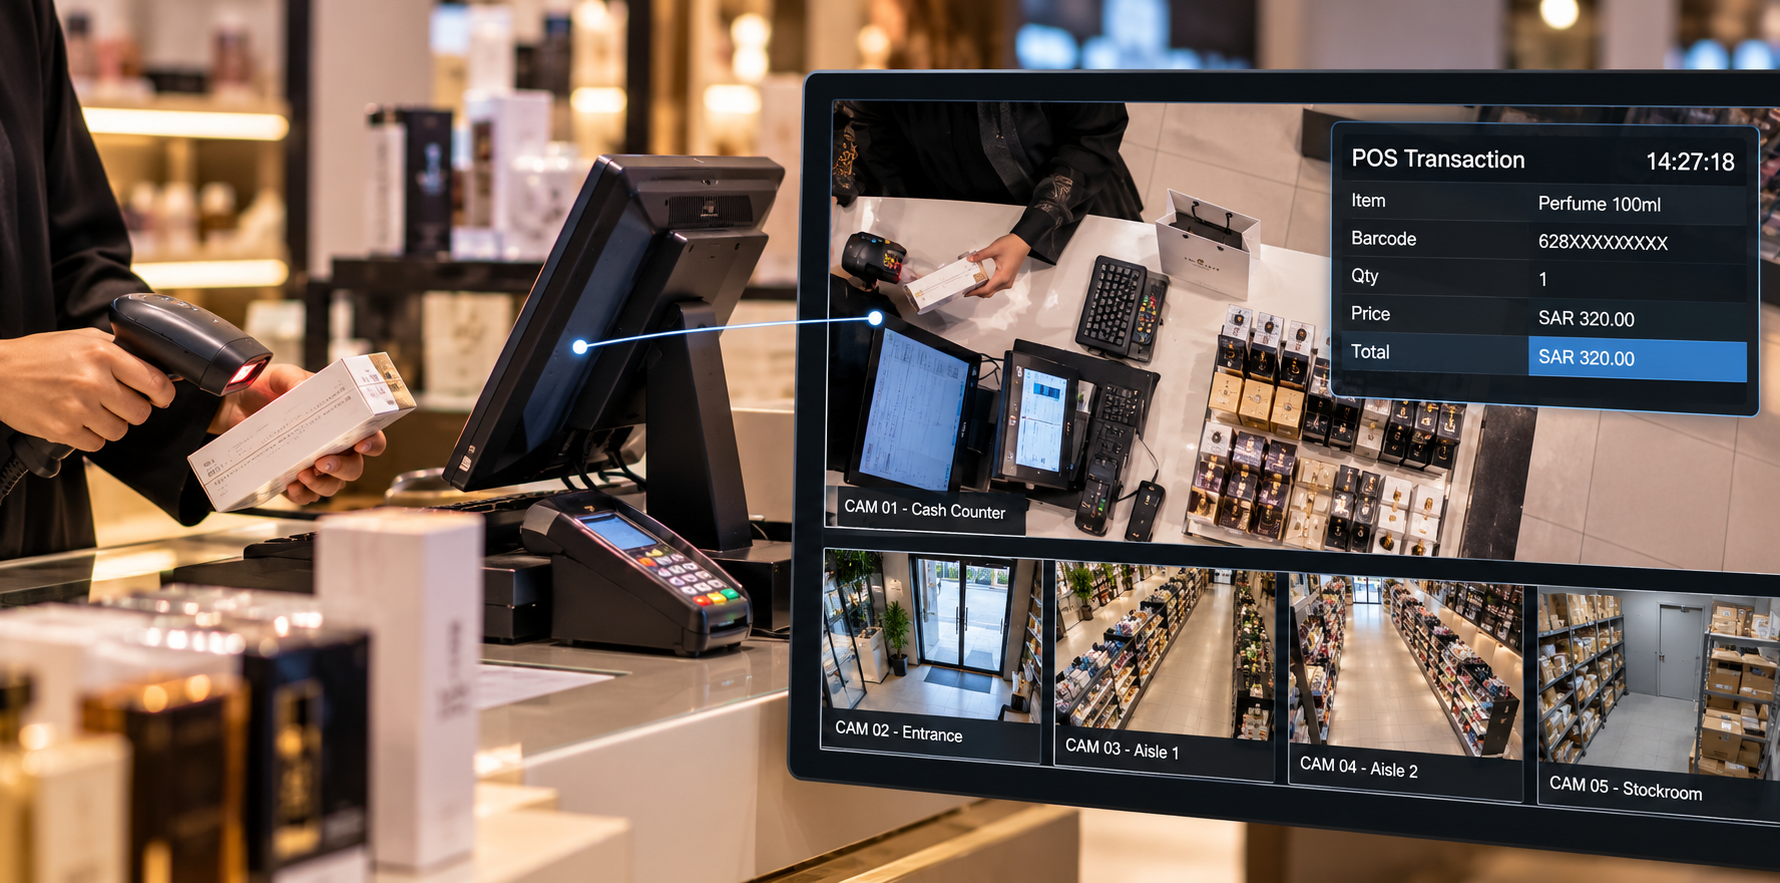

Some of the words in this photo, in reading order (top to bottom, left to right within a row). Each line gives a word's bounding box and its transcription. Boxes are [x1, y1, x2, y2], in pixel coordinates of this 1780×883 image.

[1352, 148, 1398, 168] POS
[1403, 148, 1525, 169] Transaction
[1647, 151, 1735, 171] 14:27:18
[1352, 192, 1386, 208] Item
[1539, 195, 1607, 212] Perfume
[1612, 196, 1661, 213] 100ml
[1352, 230, 1417, 247] Barcode
[1538, 233, 1669, 251] 628XXXXXXXXX
[1351, 267, 1379, 286] Qty
[1539, 271, 1547, 287] 1
[1351, 305, 1391, 322] Price
[1538, 309, 1575, 326] SAR
[1579, 310, 1635, 328] 320.00
[1351, 343, 1390, 360] Total
[1538, 348, 1575, 365] SAR
[1579, 349, 1635, 367] 320.00
[844, 498, 878, 514] CAM
[881, 501, 897, 515] 01
[911, 501, 947, 517] Cash
[950, 503, 1006, 520] Counter
[835, 719, 869, 736] CAM
[872, 722, 890, 738] 02
[902, 724, 963, 743] Entrance
[1065, 737, 1100, 754] CAM
[1103, 740, 1121, 756] 03
[1133, 743, 1168, 760] Aisle
[1172, 746, 1179, 760] 1
[1300, 755, 1335, 772] CAM
[1339, 758, 1358, 774] 04
[1370, 761, 1406, 778] Aisle
[1409, 764, 1418, 779] 2
[1549, 775, 1586, 792] CAM
[1590, 778, 1609, 794] 05
[1623, 780, 1703, 801] Stockroom
